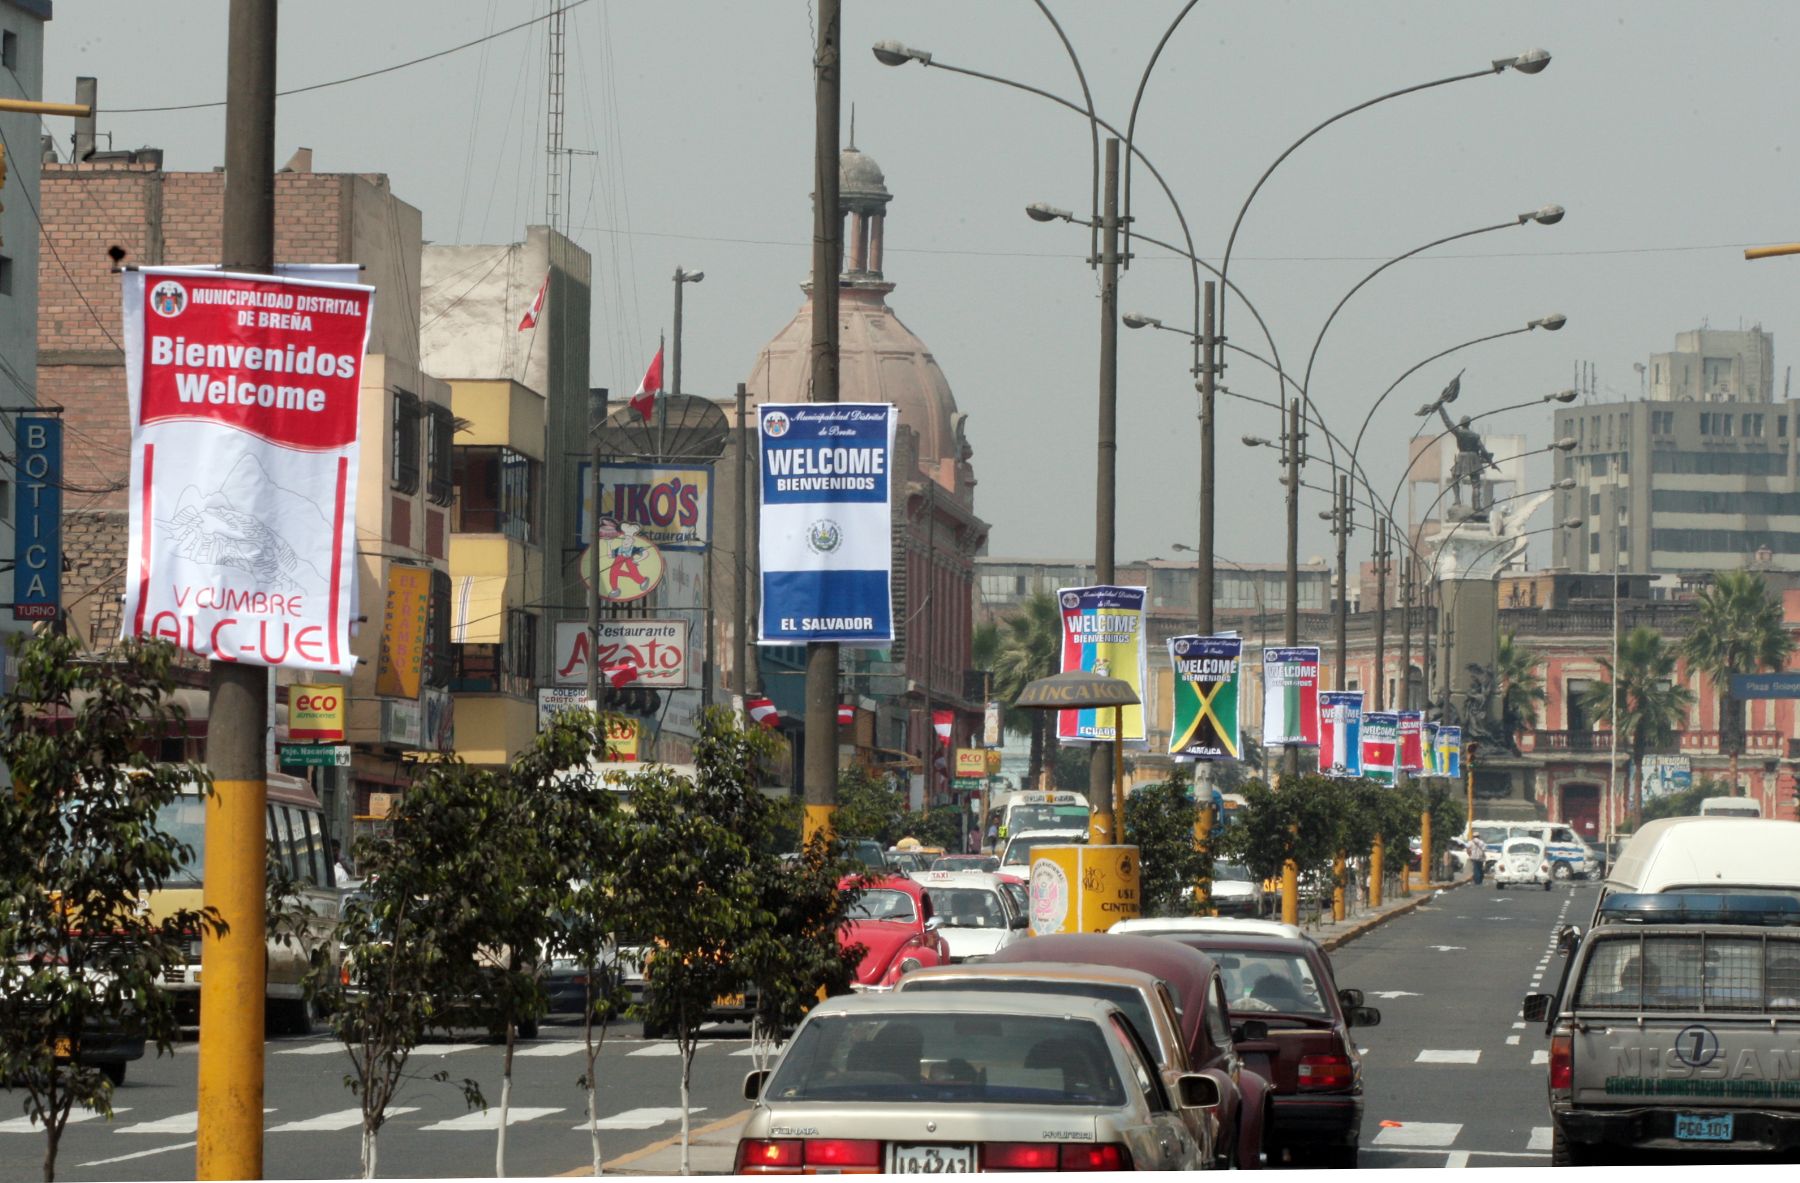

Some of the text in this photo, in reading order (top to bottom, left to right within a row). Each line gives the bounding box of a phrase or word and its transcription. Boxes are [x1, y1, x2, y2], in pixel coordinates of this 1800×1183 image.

[192, 288, 361, 316] MUNICIPALIDAD DISTRITAL
[237, 310, 312, 331] DE BREÑA
[151, 335, 355, 379] Bienvenidos
[175, 373, 326, 412] Welcome
[790, 410, 886, 423] Municipalidad Distrital
[818, 425, 857, 436] de Breña
[767, 448, 884, 476] WELCOME
[777, 477, 875, 492] BIENVENIDOS
[26, 425, 48, 598] BOTICA
[173, 584, 302, 618] V CUMBRE
[17, 605, 56, 617] TURNO
[781, 617, 873, 631] EL SALVADOR
[1067, 615, 1137, 633] WELCOME
[151, 611, 325, 665] ALC-UE
[1073, 634, 1129, 644] BIENVENIDOS
[1177, 659, 1237, 674] WELCOME
[1270, 666, 1316, 678] WELCOME
[1040, 682, 1089, 701] INCA
[296, 695, 337, 711] eco
[1080, 727, 1116, 736] ECUADO
[1186, 746, 1222, 755] JAMAICA
[1118, 889, 1134, 899] USE
[1689, 1032, 1705, 1062] 7
[1609, 1046, 1800, 1081] NISSAN
